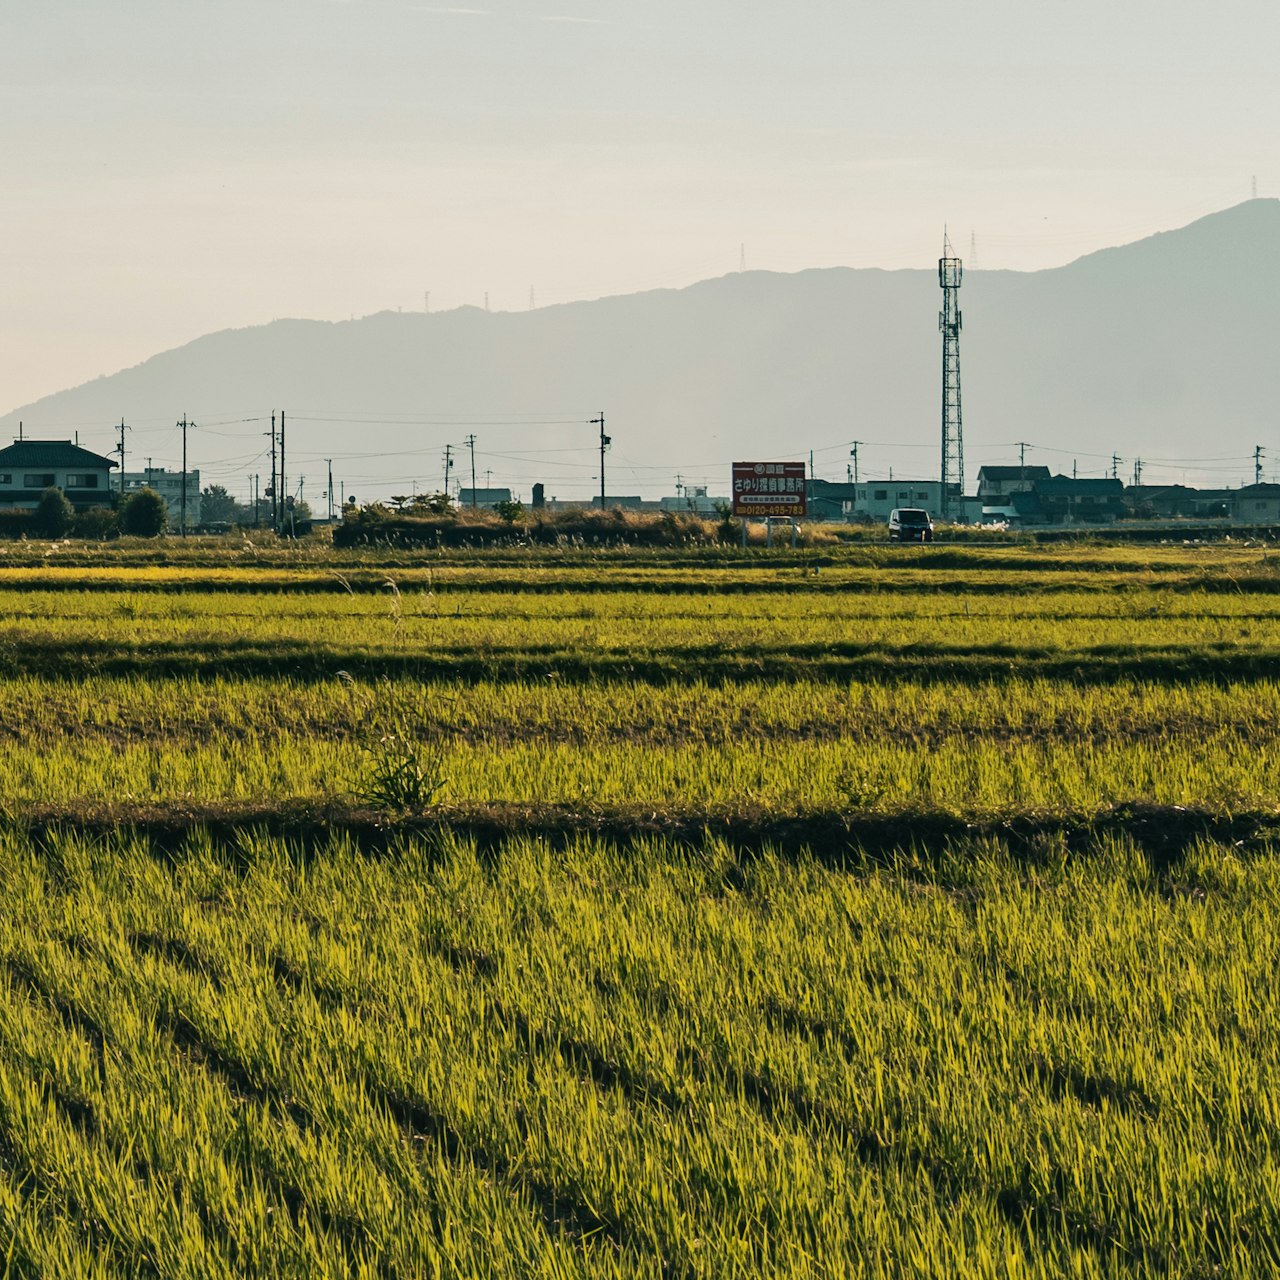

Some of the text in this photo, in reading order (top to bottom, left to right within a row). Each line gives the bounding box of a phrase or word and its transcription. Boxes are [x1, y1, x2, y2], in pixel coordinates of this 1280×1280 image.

[734, 477, 804, 492] さゆり探偵事務所
[746, 505, 804, 515] 0120-495-783
